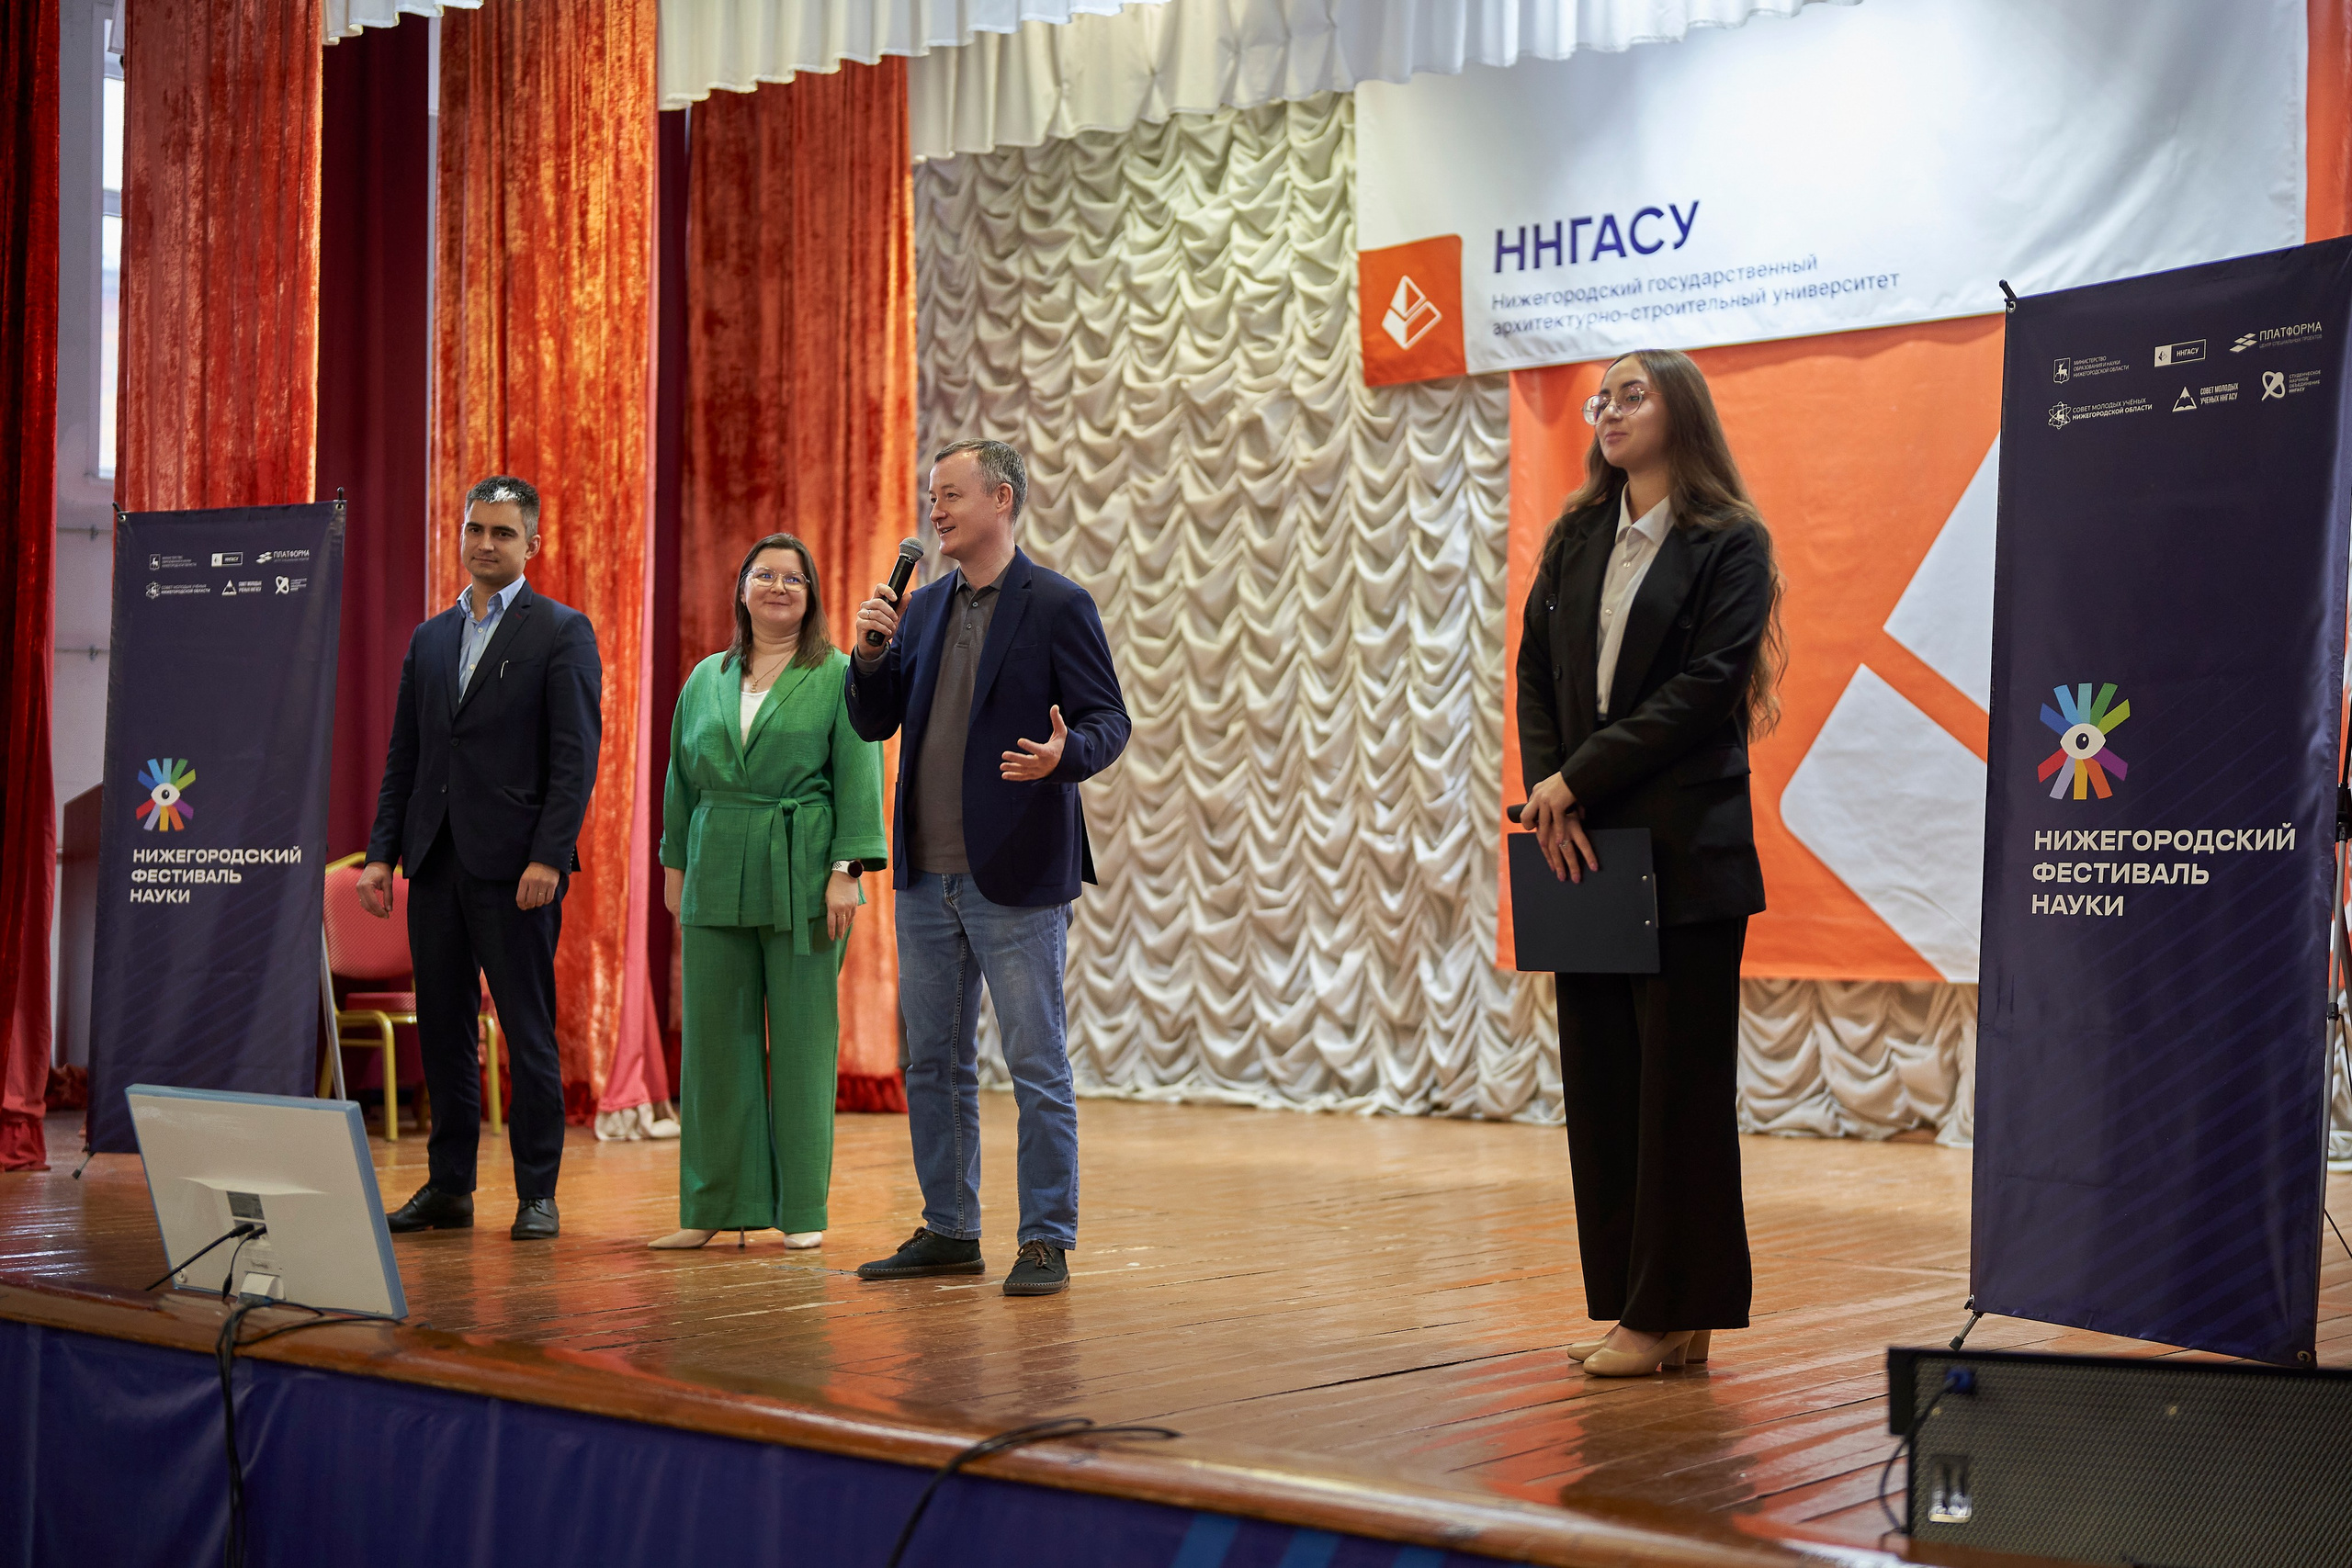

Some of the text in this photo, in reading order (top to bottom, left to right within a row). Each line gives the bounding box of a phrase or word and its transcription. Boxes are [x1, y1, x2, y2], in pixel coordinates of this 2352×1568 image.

[1494, 200, 1700, 274] ННГАСУ
[1492, 254, 1818, 310] Нижегородский государственный
[1493, 273, 1900, 337] архитектурно-строительный университет
[2259, 321, 2323, 341] ПЛАТФОРМА
[2176, 347, 2199, 357] ННГАСУ
[2072, 405, 2091, 413] СОВЕТ
[2091, 400, 2122, 411] МОЛОДЫХ
[2072, 403, 2153, 421] НИЖЕГОРОДСКОЙ ОБЛАСТИ
[2033, 822, 2296, 854] НИЖЕГОРОДСКИЙ
[132, 845, 302, 865] НИЖЕГОРОДСКИЙ
[130, 868, 243, 884] ФЕСТИВАЛЬ
[2032, 862, 2210, 885] ФЕСТИВАЛЬ
[130, 888, 191, 904] НАУКИ
[2031, 894, 2124, 917] НАУКИ
